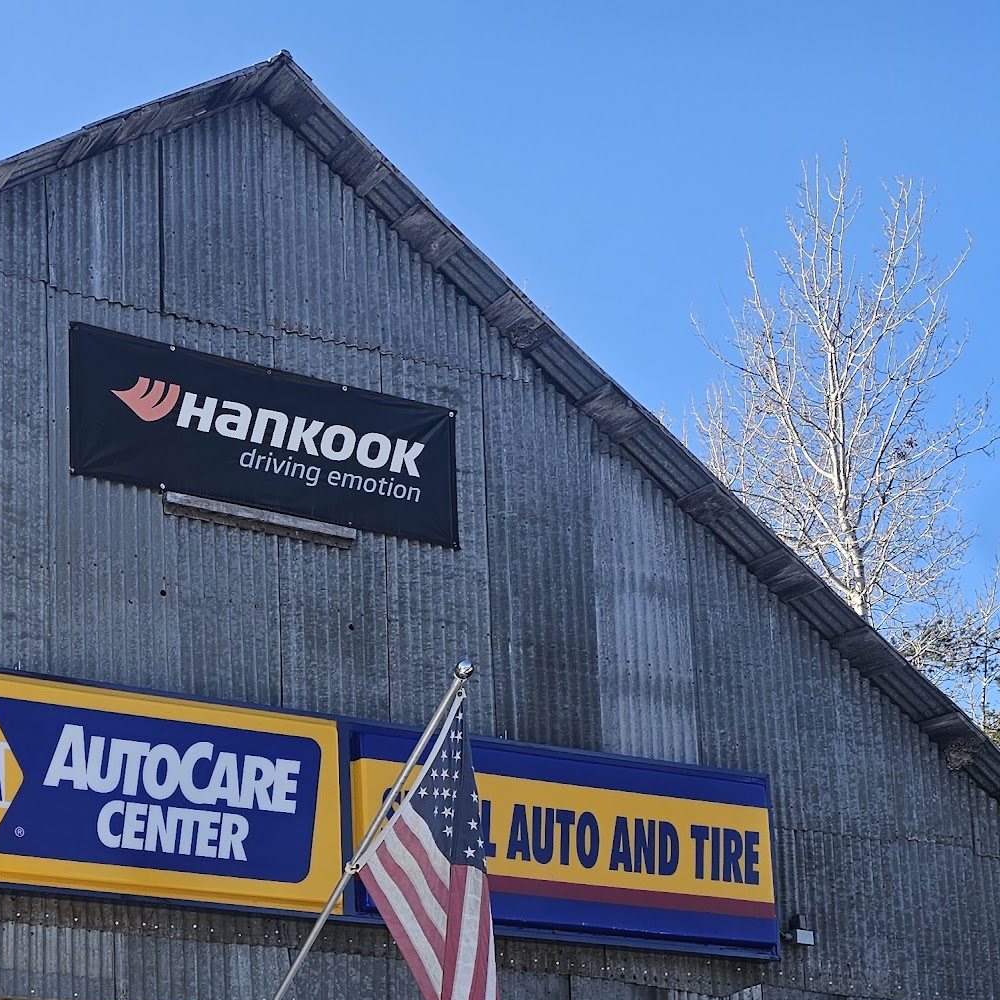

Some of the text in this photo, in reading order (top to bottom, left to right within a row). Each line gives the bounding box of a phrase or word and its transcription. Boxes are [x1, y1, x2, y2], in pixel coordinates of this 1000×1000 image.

[239, 449, 421, 503] driving emotion
[97, 800, 250, 862] CENTER
[506, 803, 601, 869] AUTO
[609, 816, 680, 876] AND
[690, 824, 760, 886] TIRE
